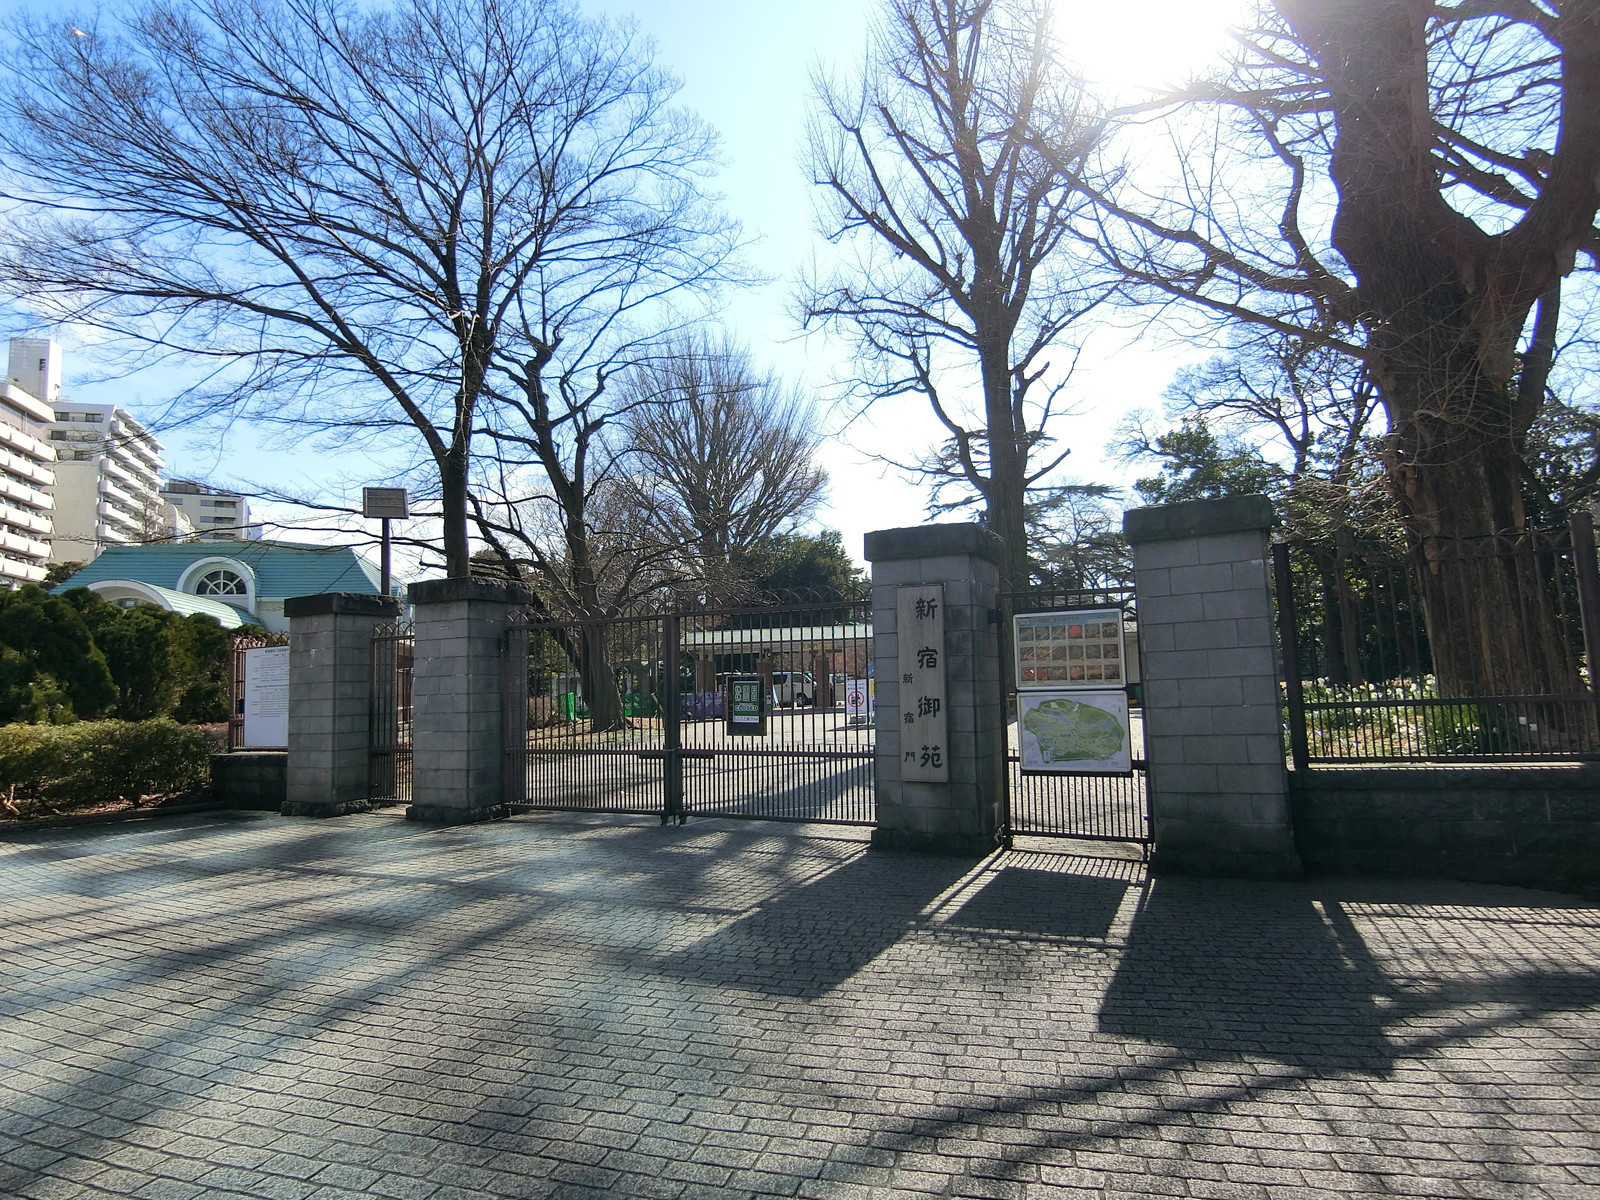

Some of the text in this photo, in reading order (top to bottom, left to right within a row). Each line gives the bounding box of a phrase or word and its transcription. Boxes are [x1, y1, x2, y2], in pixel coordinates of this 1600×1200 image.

[902, 673, 916, 762] 新宿門
[915, 597, 943, 769] 新宿御苑
